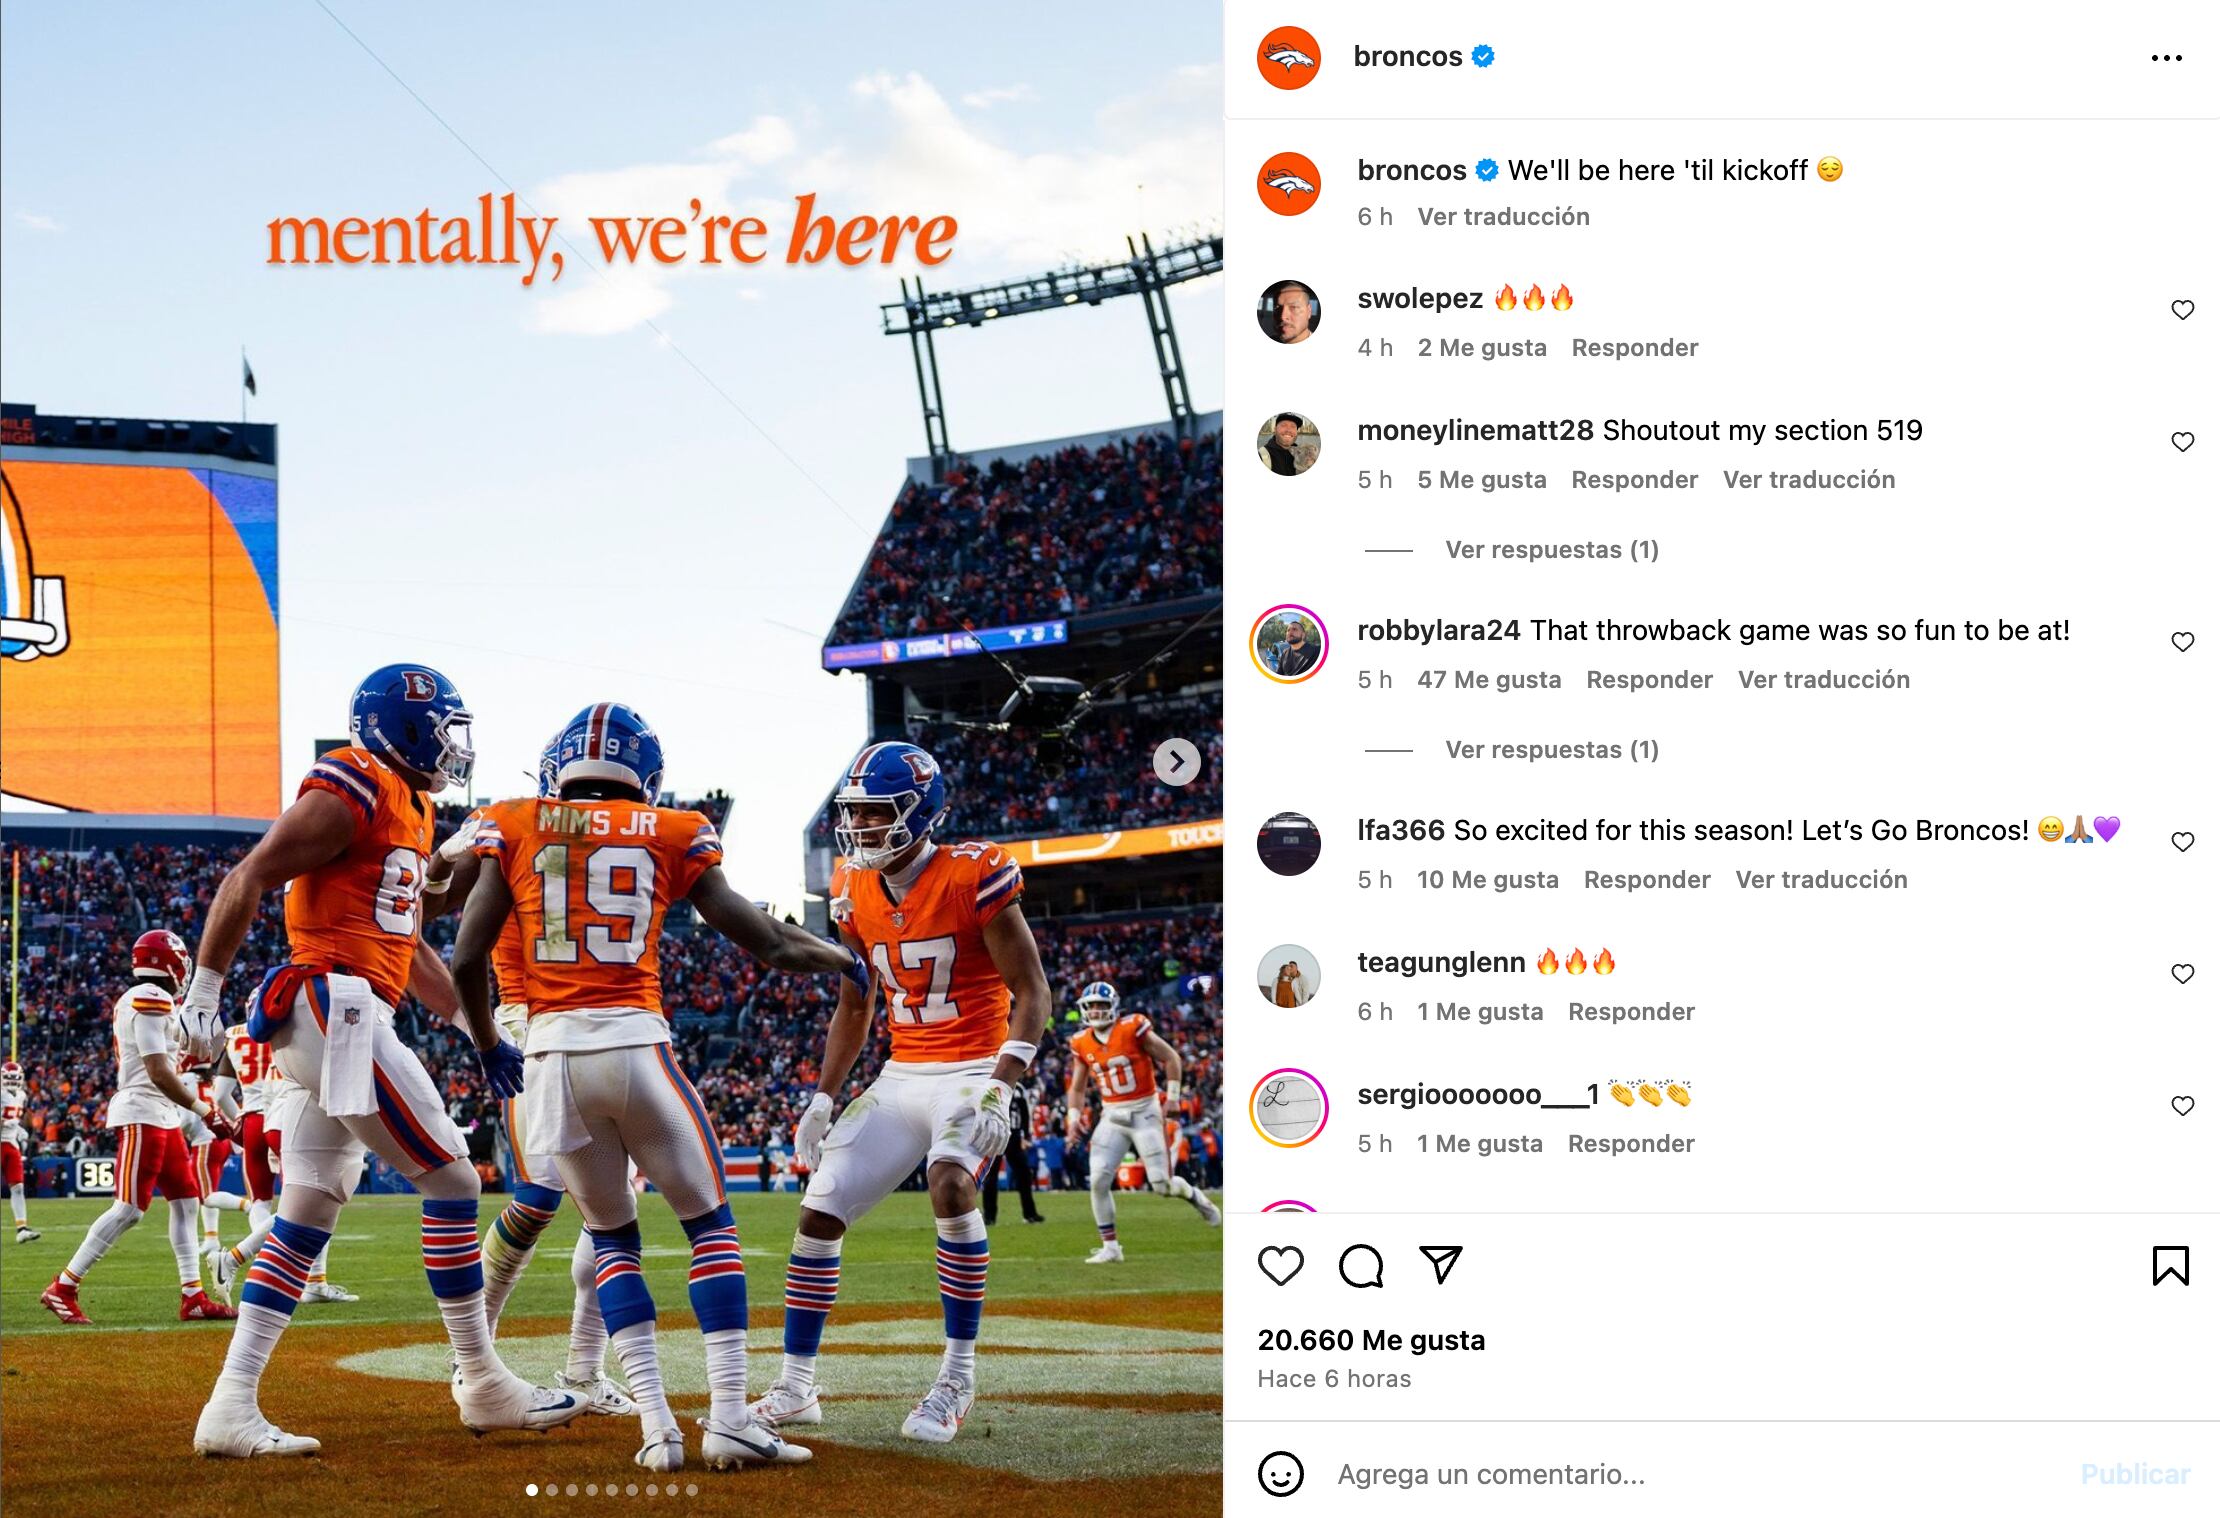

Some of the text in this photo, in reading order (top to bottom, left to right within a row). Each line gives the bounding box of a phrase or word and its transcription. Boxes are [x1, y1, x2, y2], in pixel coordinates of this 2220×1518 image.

[1355, 45, 1462, 66] broncos
[1359, 159, 1808, 180] broncos We'll be here 'til kickoff
[1359, 207, 1392, 225] 6 h
[1418, 206, 1589, 225] Ver traducción
[1359, 287, 1483, 313] swolepez
[1358, 338, 1392, 356] 4 h
[1419, 338, 1546, 361] 2 Me gusta
[1573, 338, 1699, 360] Responder
[1359, 418, 1922, 445] moneylinematt28 Shoutout my section 519
[1359, 470, 1391, 488] 5 h
[1419, 471, 1546, 493] 5 Me gusta
[1573, 470, 1698, 492] Responder
[1723, 469, 1895, 488] Ver traducción
[1446, 540, 1658, 562] Ver respuestas (1)
[1359, 619, 2069, 646] robbylara24 That throwback game was so fun to be at!
[402, 671, 437, 701] D
[1359, 670, 1391, 688] 5 h
[1418, 671, 1561, 693] 47 Me gusta
[1588, 670, 1713, 692] Responder
[1739, 669, 1909, 688] Ver traducción
[1446, 740, 1658, 762] Ver respuestas (1)
[539, 804, 658, 837] MIMS JR
[1359, 819, 2028, 841] lfa366 So excited for this season! Let’s Go Broncos!
[1359, 870, 1391, 888] 5 h
[1418, 870, 1558, 893] 10 Me gusta
[1586, 870, 1711, 892] Responder
[1736, 869, 1907, 888] Ver traducción
[533, 844, 656, 964] 19
[1358, 951, 1525, 977] teagunglenn
[871, 935, 960, 1025] 17
[1359, 1002, 1392, 1020] 6 h
[1419, 1003, 1543, 1025] 1 Me gusta
[1570, 1002, 1695, 1024] Responder
[1093, 1055, 1136, 1096] 10
[1359, 1082, 1597, 1109] sergiooooooo___1
[1359, 1134, 1391, 1152] 5 h
[1418, 1135, 1542, 1157] 1 Me gusta
[1570, 1134, 1695, 1156] Responder
[84, 1163, 114, 1187] 36
[1259, 1329, 1485, 1355] 20.660 Me gusta
[1259, 1369, 1411, 1387] Hace 6 horas
[1338, 1463, 1644, 1489] Agrega un comentario...
[2082, 1462, 2191, 1484] Publicar
